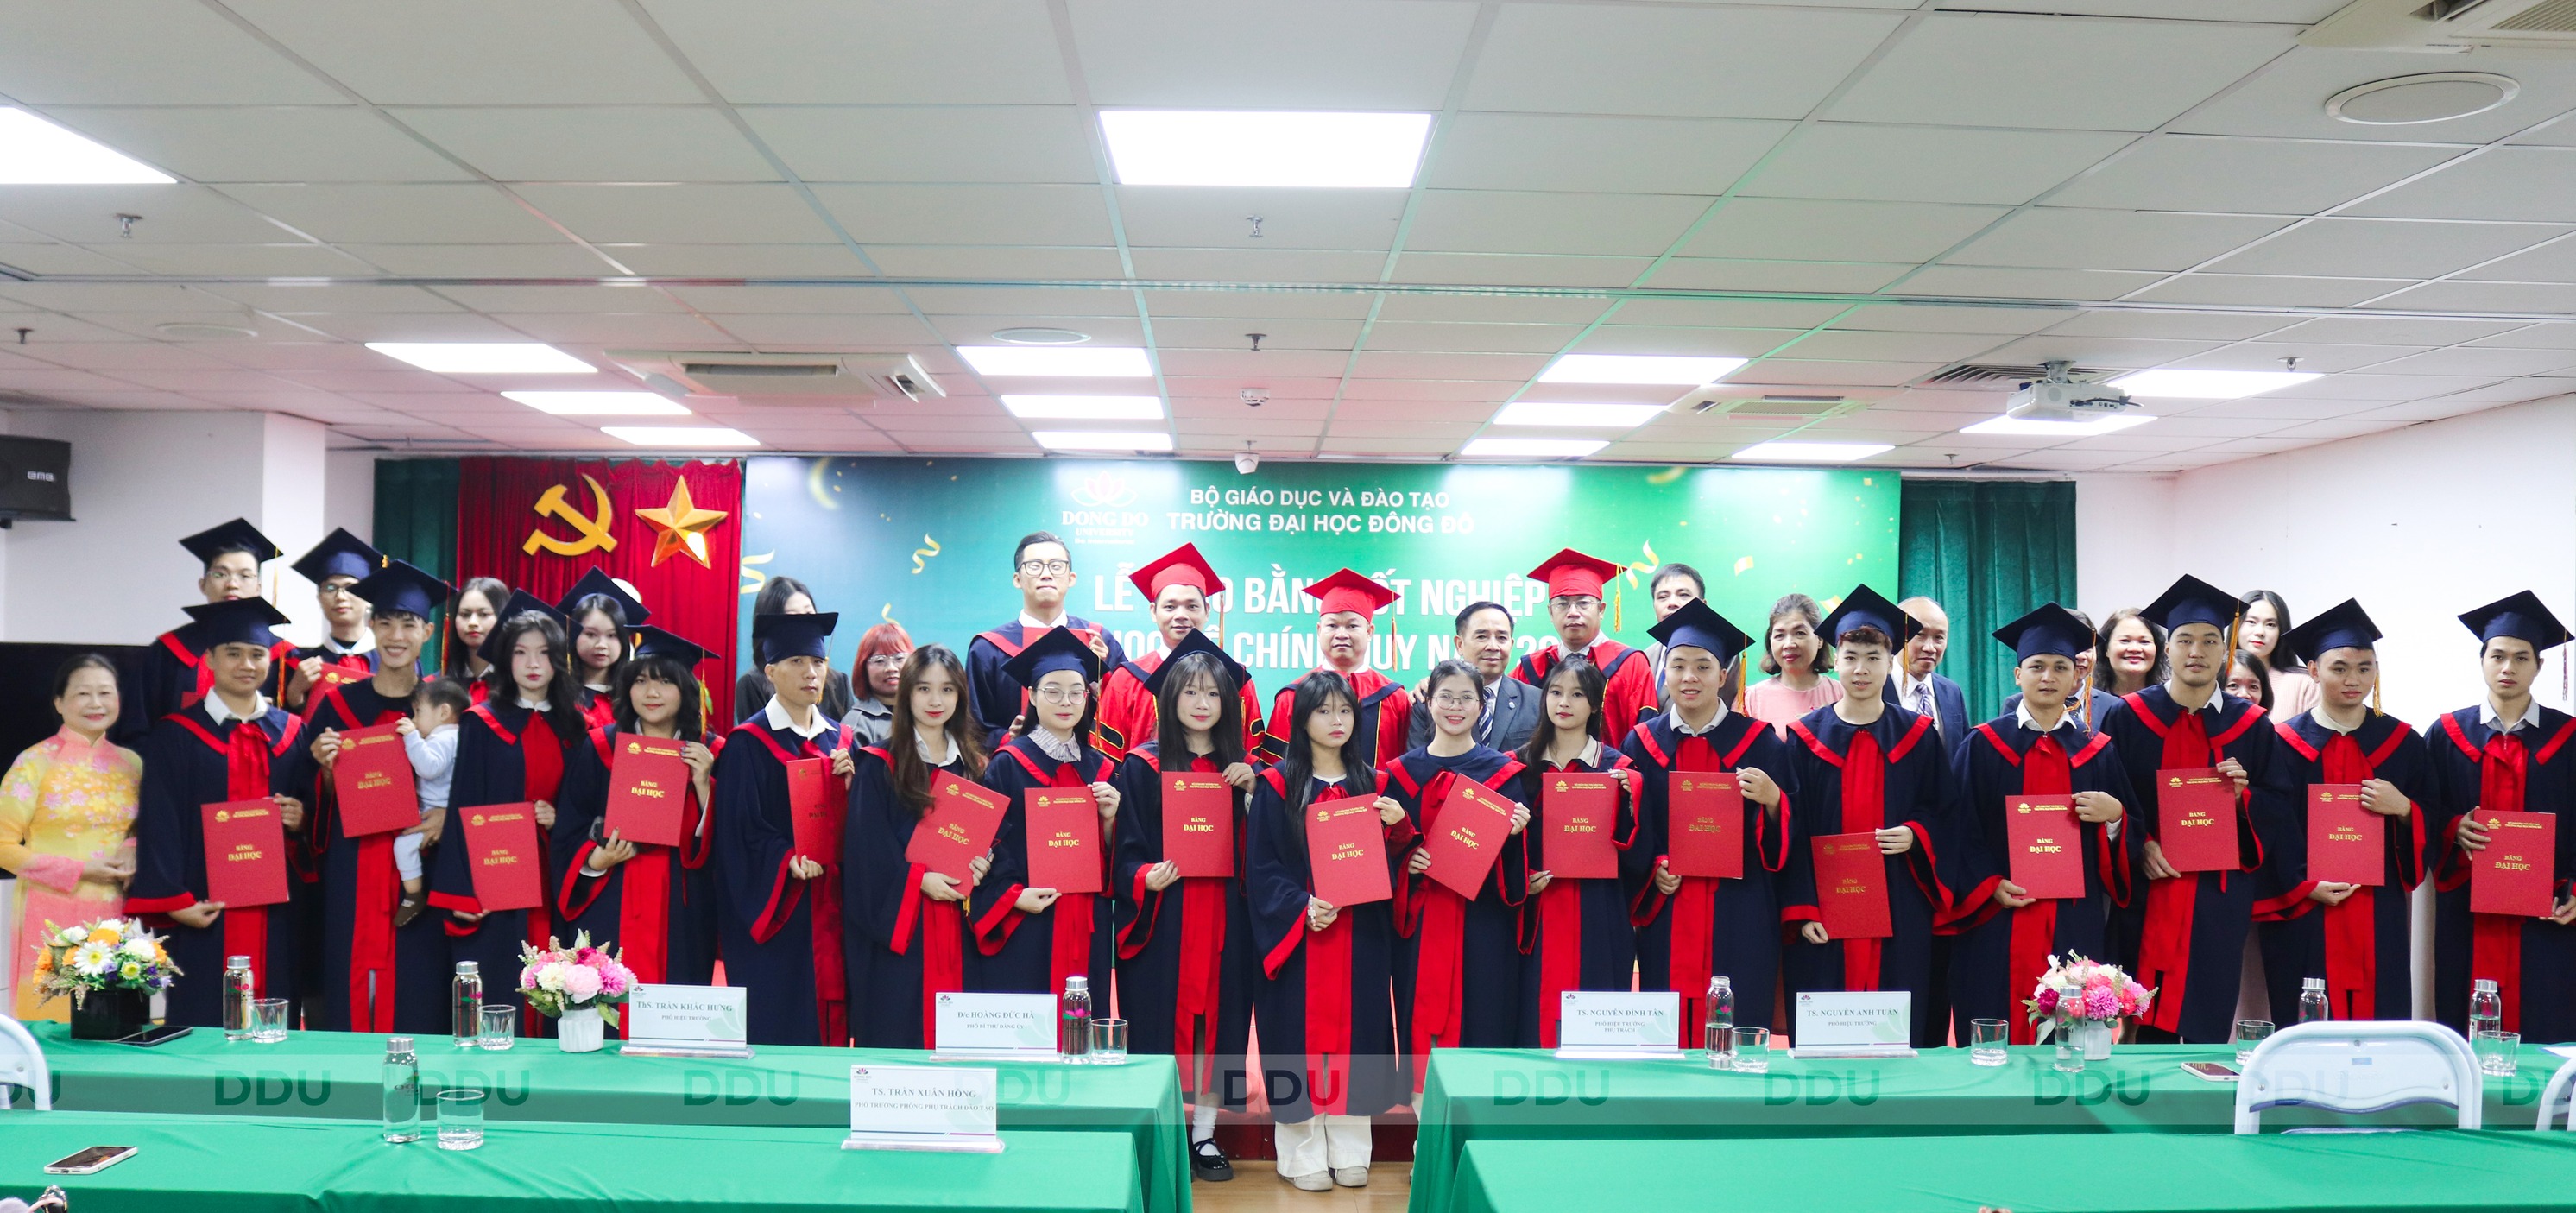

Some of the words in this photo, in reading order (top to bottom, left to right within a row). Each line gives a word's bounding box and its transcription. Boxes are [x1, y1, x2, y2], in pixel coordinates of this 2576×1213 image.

[1191, 486, 1219, 507] BỘ
[1225, 486, 1274, 506] GIÁO
[1280, 490, 1322, 509] DỤC
[1329, 487, 1355, 507] VÀ
[1361, 487, 1404, 507] ĐÀO
[1409, 491, 1449, 511] TẠO
[1166, 509, 1261, 531] TRƯỜNG
[1269, 514, 1305, 534] ĐẠI
[1313, 515, 1361, 535] HỌC
[1369, 511, 1434, 534] ĐÔNG
[1441, 511, 1475, 534] ĐÔ
[1245, 563, 1323, 614] BẰN
[1234, 625, 1323, 669] CHÍN
[971, 1010, 1001, 1019] HOÀNG
